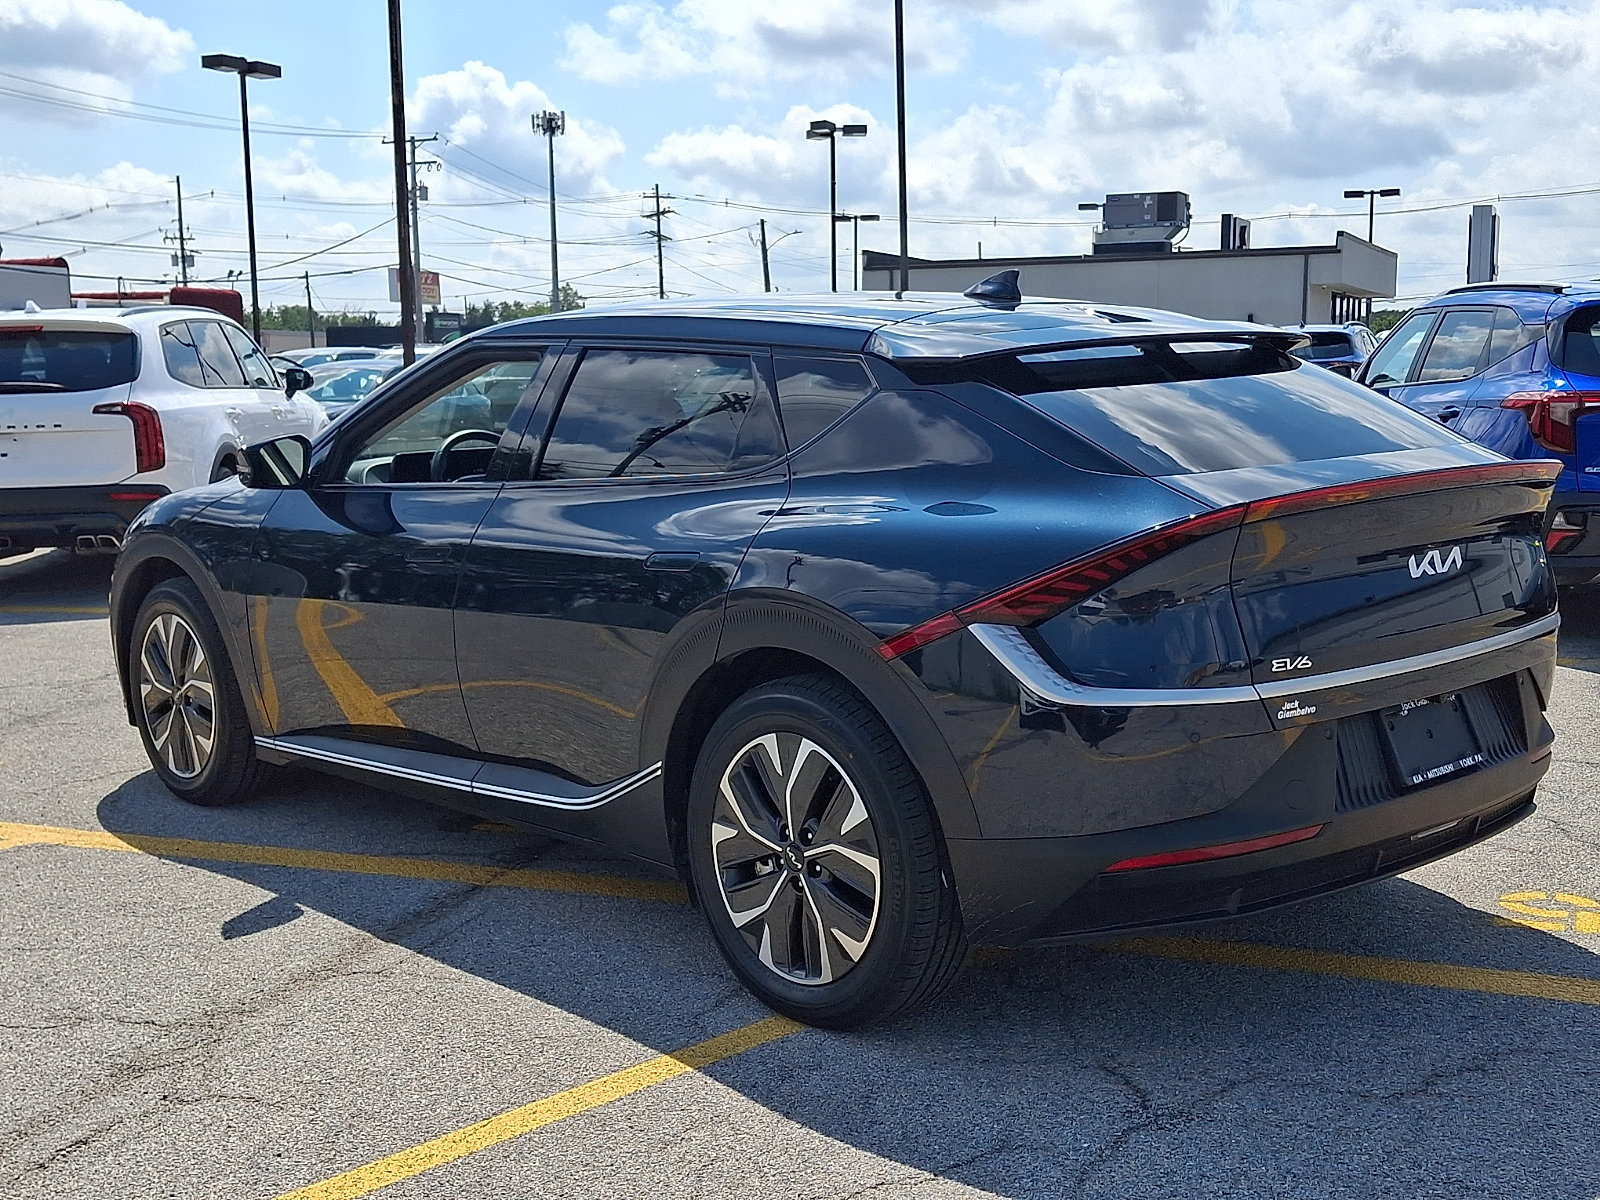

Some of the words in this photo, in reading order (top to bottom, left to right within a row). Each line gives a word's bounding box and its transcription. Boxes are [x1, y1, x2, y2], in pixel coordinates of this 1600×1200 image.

[1409, 546, 1463, 579] KIA
[1271, 655, 1313, 672] EV6
[1277, 706, 1317, 720] Giambalvo
[1282, 699, 1300, 711] Jack
[1412, 773, 1424, 784] KIA
[1427, 763, 1455, 780] MITSUBISHI
